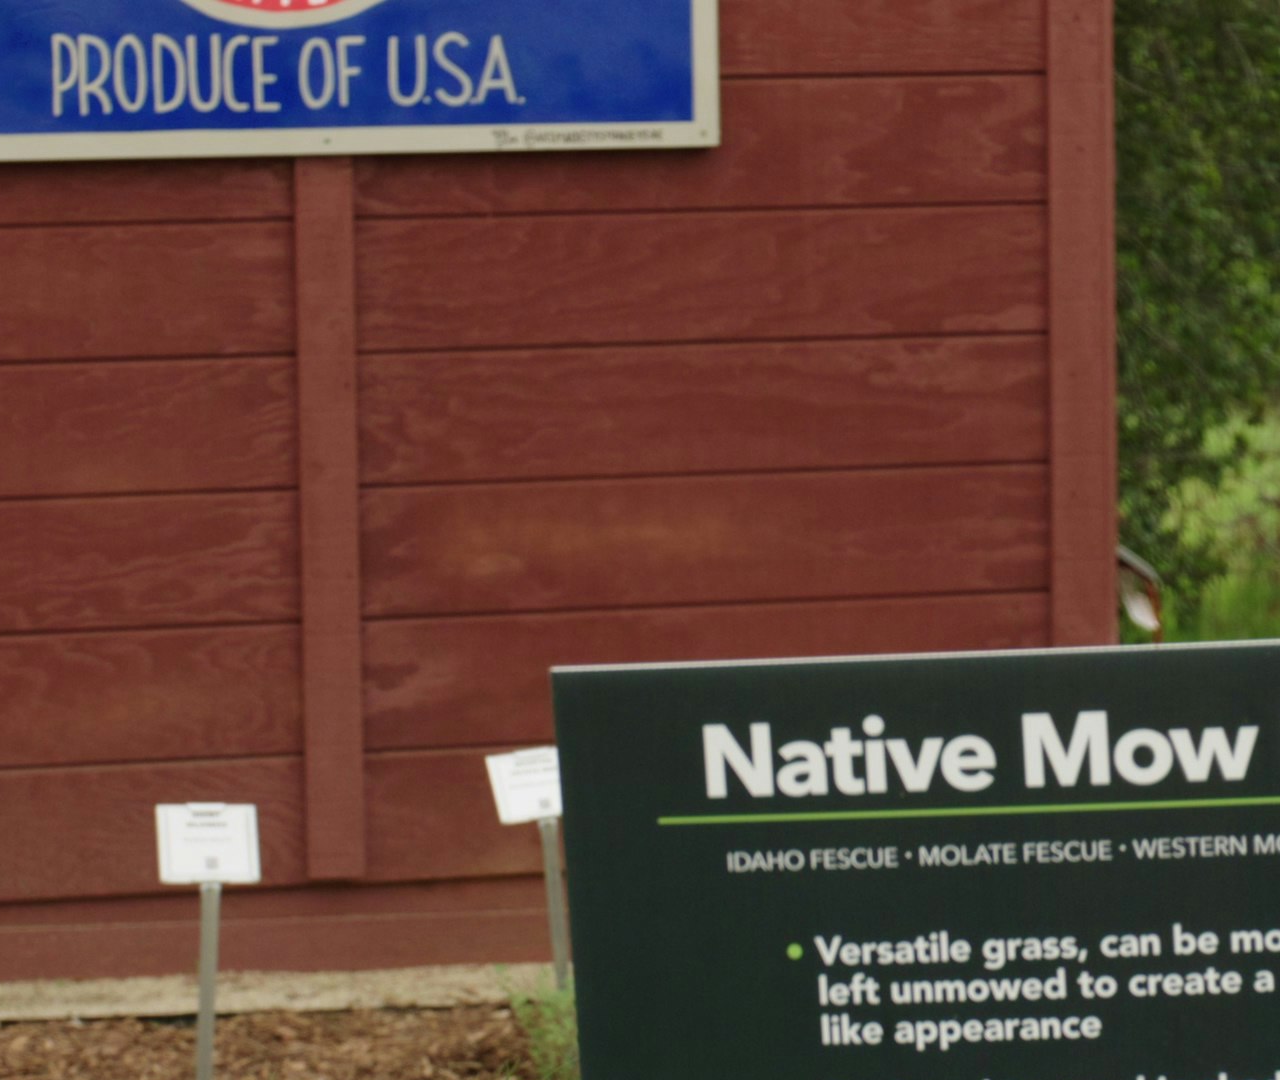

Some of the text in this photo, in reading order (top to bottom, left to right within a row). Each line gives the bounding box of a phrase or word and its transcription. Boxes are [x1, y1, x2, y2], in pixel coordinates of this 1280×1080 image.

[51, 31, 526, 116] PRODUCE OF U.S.A.
[702, 714, 997, 799] Native
[1021, 711, 1259, 788] Mow
[726, 849, 806, 873] IDAHO
[809, 846, 899, 871] FESCUE
[917, 842, 1018, 867] MOLATE
[1022, 839, 1113, 864] FESCUE
[1131, 834, 1248, 860] WESTERN
[813, 930, 972, 966] Versatile
[981, 936, 1088, 971] grass,
[1099, 933, 1162, 958] can
[1172, 922, 1220, 956] be
[817, 972, 881, 1006] left
[890, 966, 1067, 1005] unmowed
[1076, 970, 1118, 999] to
[1128, 966, 1243, 998] create
[1253, 969, 1275, 993] a
[820, 1013, 1103, 1052] like appearance
